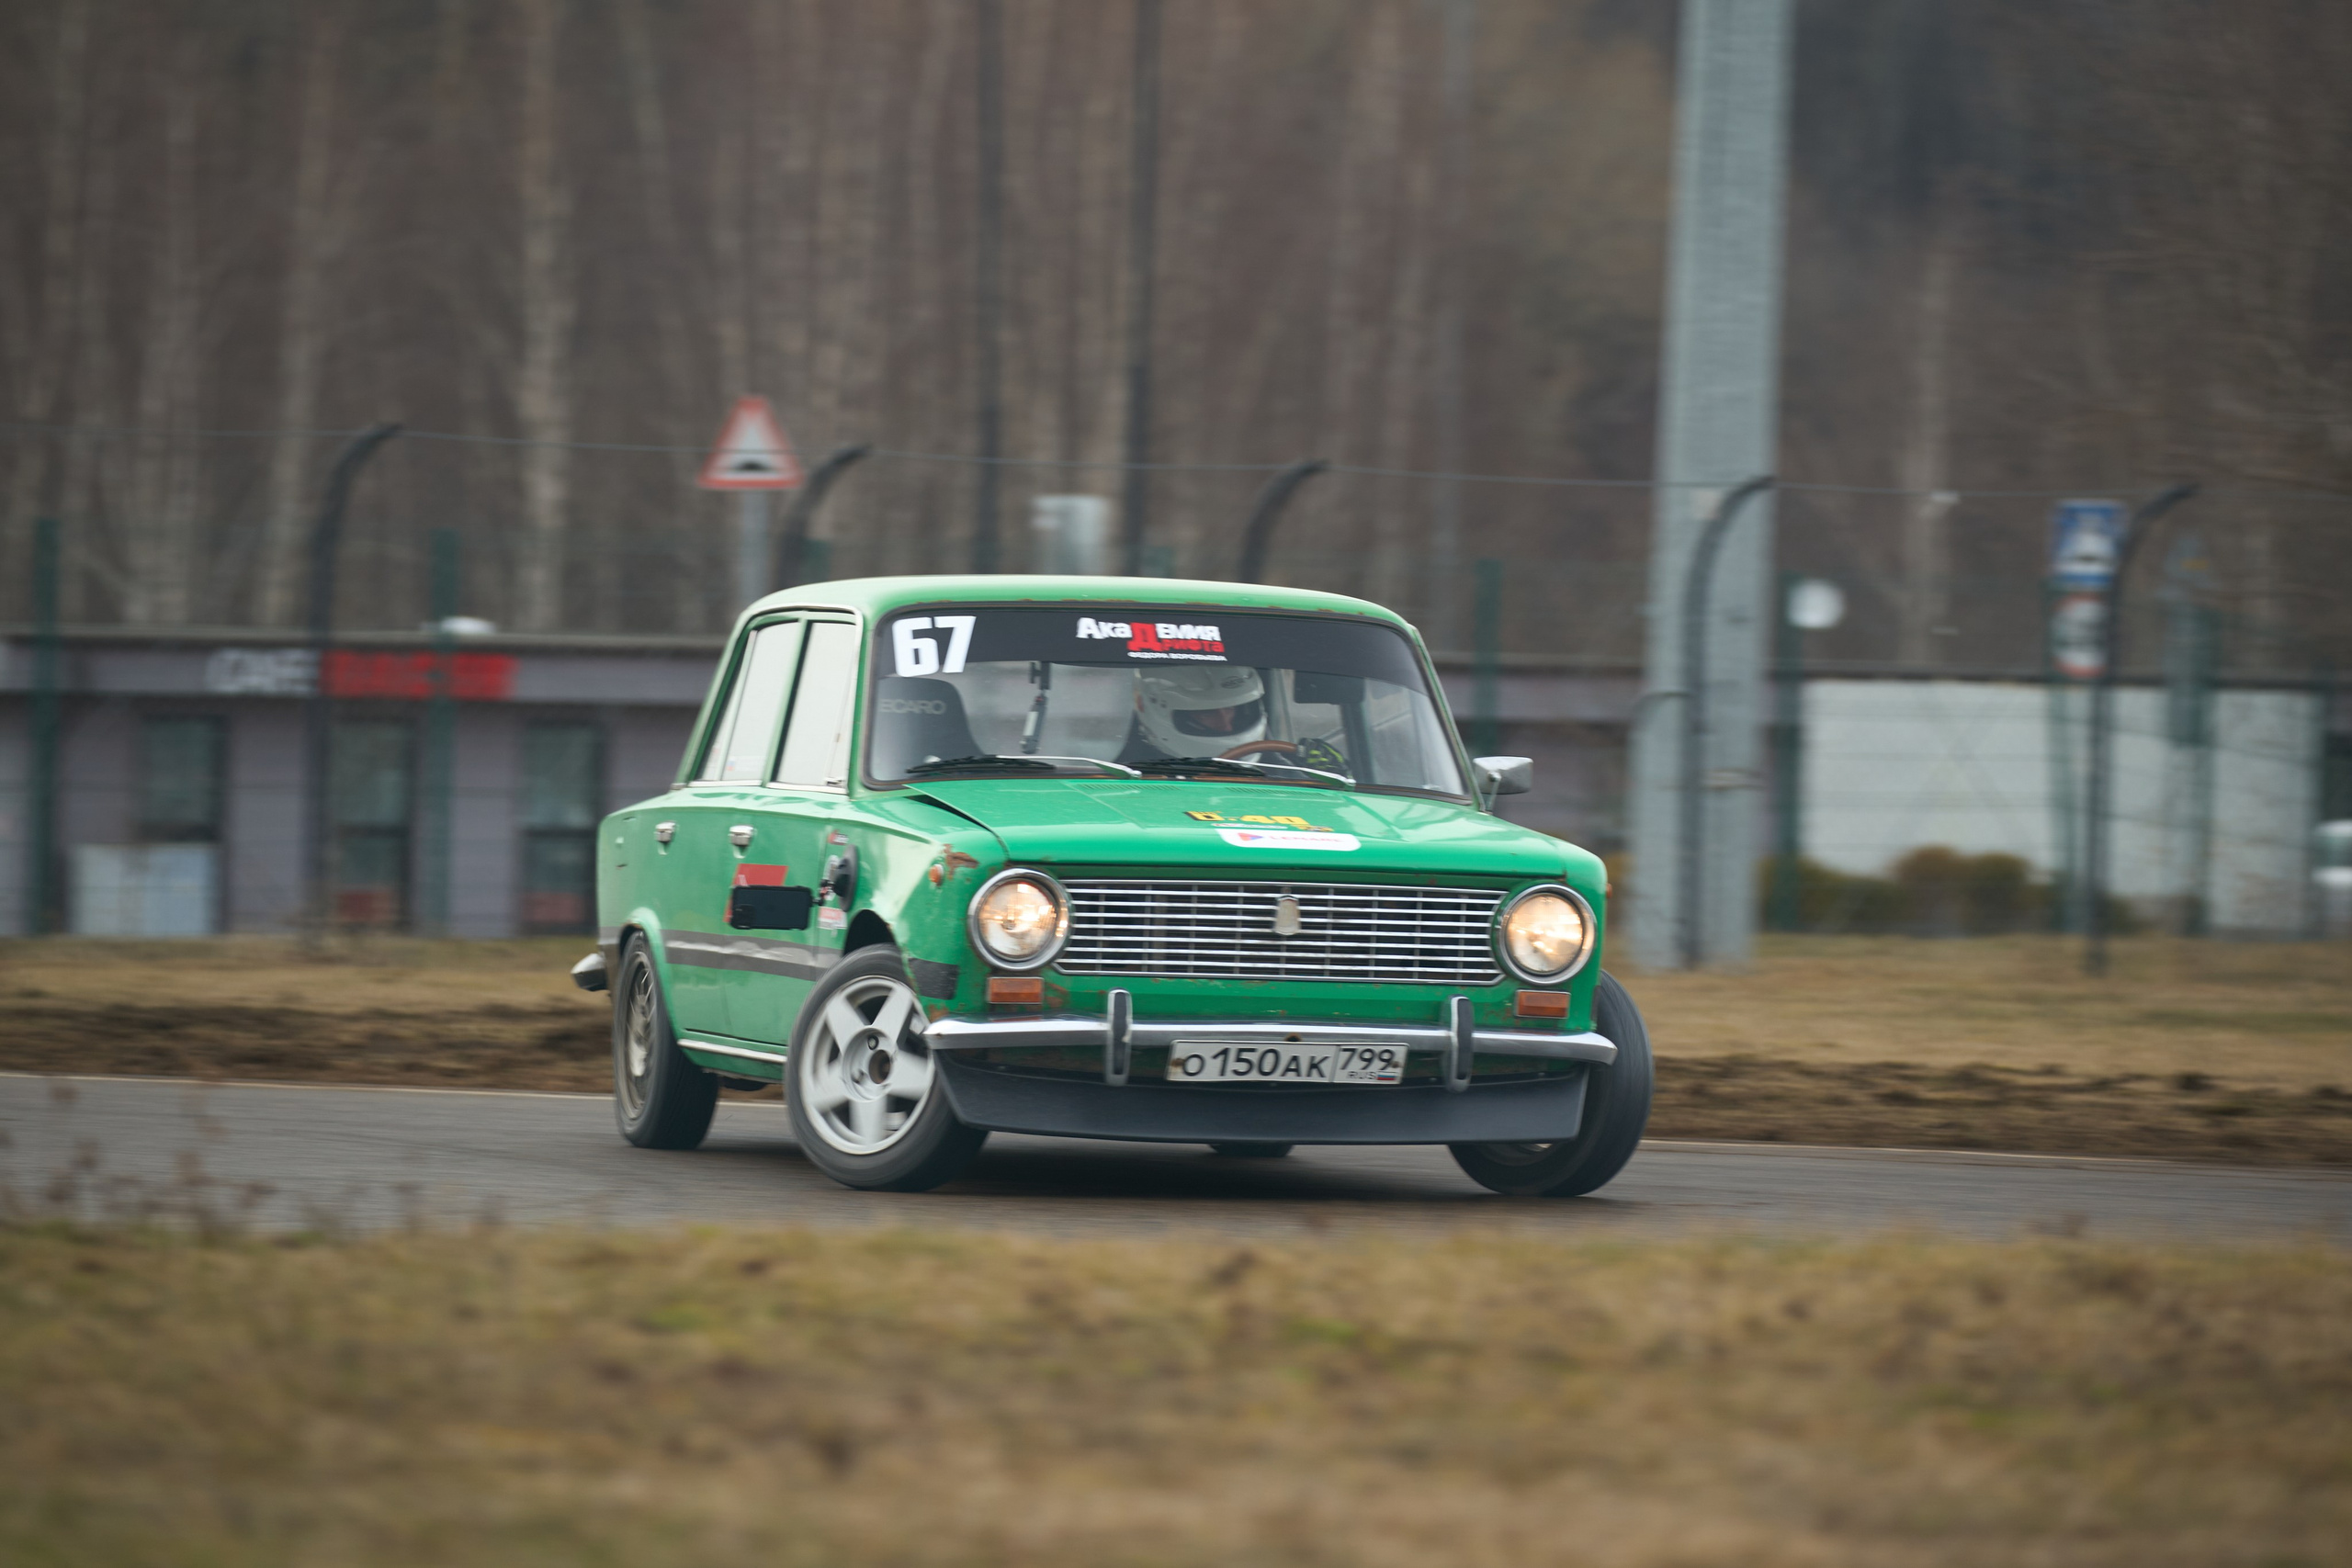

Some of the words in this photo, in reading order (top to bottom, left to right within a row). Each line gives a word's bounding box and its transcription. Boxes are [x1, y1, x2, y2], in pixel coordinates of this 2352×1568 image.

[892, 615, 977, 677] 67
[879, 699, 946, 715] ECARO
[1182, 1046, 1331, 1077] О150АК
[1340, 1047, 1396, 1071] 799
[1346, 1070, 1377, 1080] RUS
